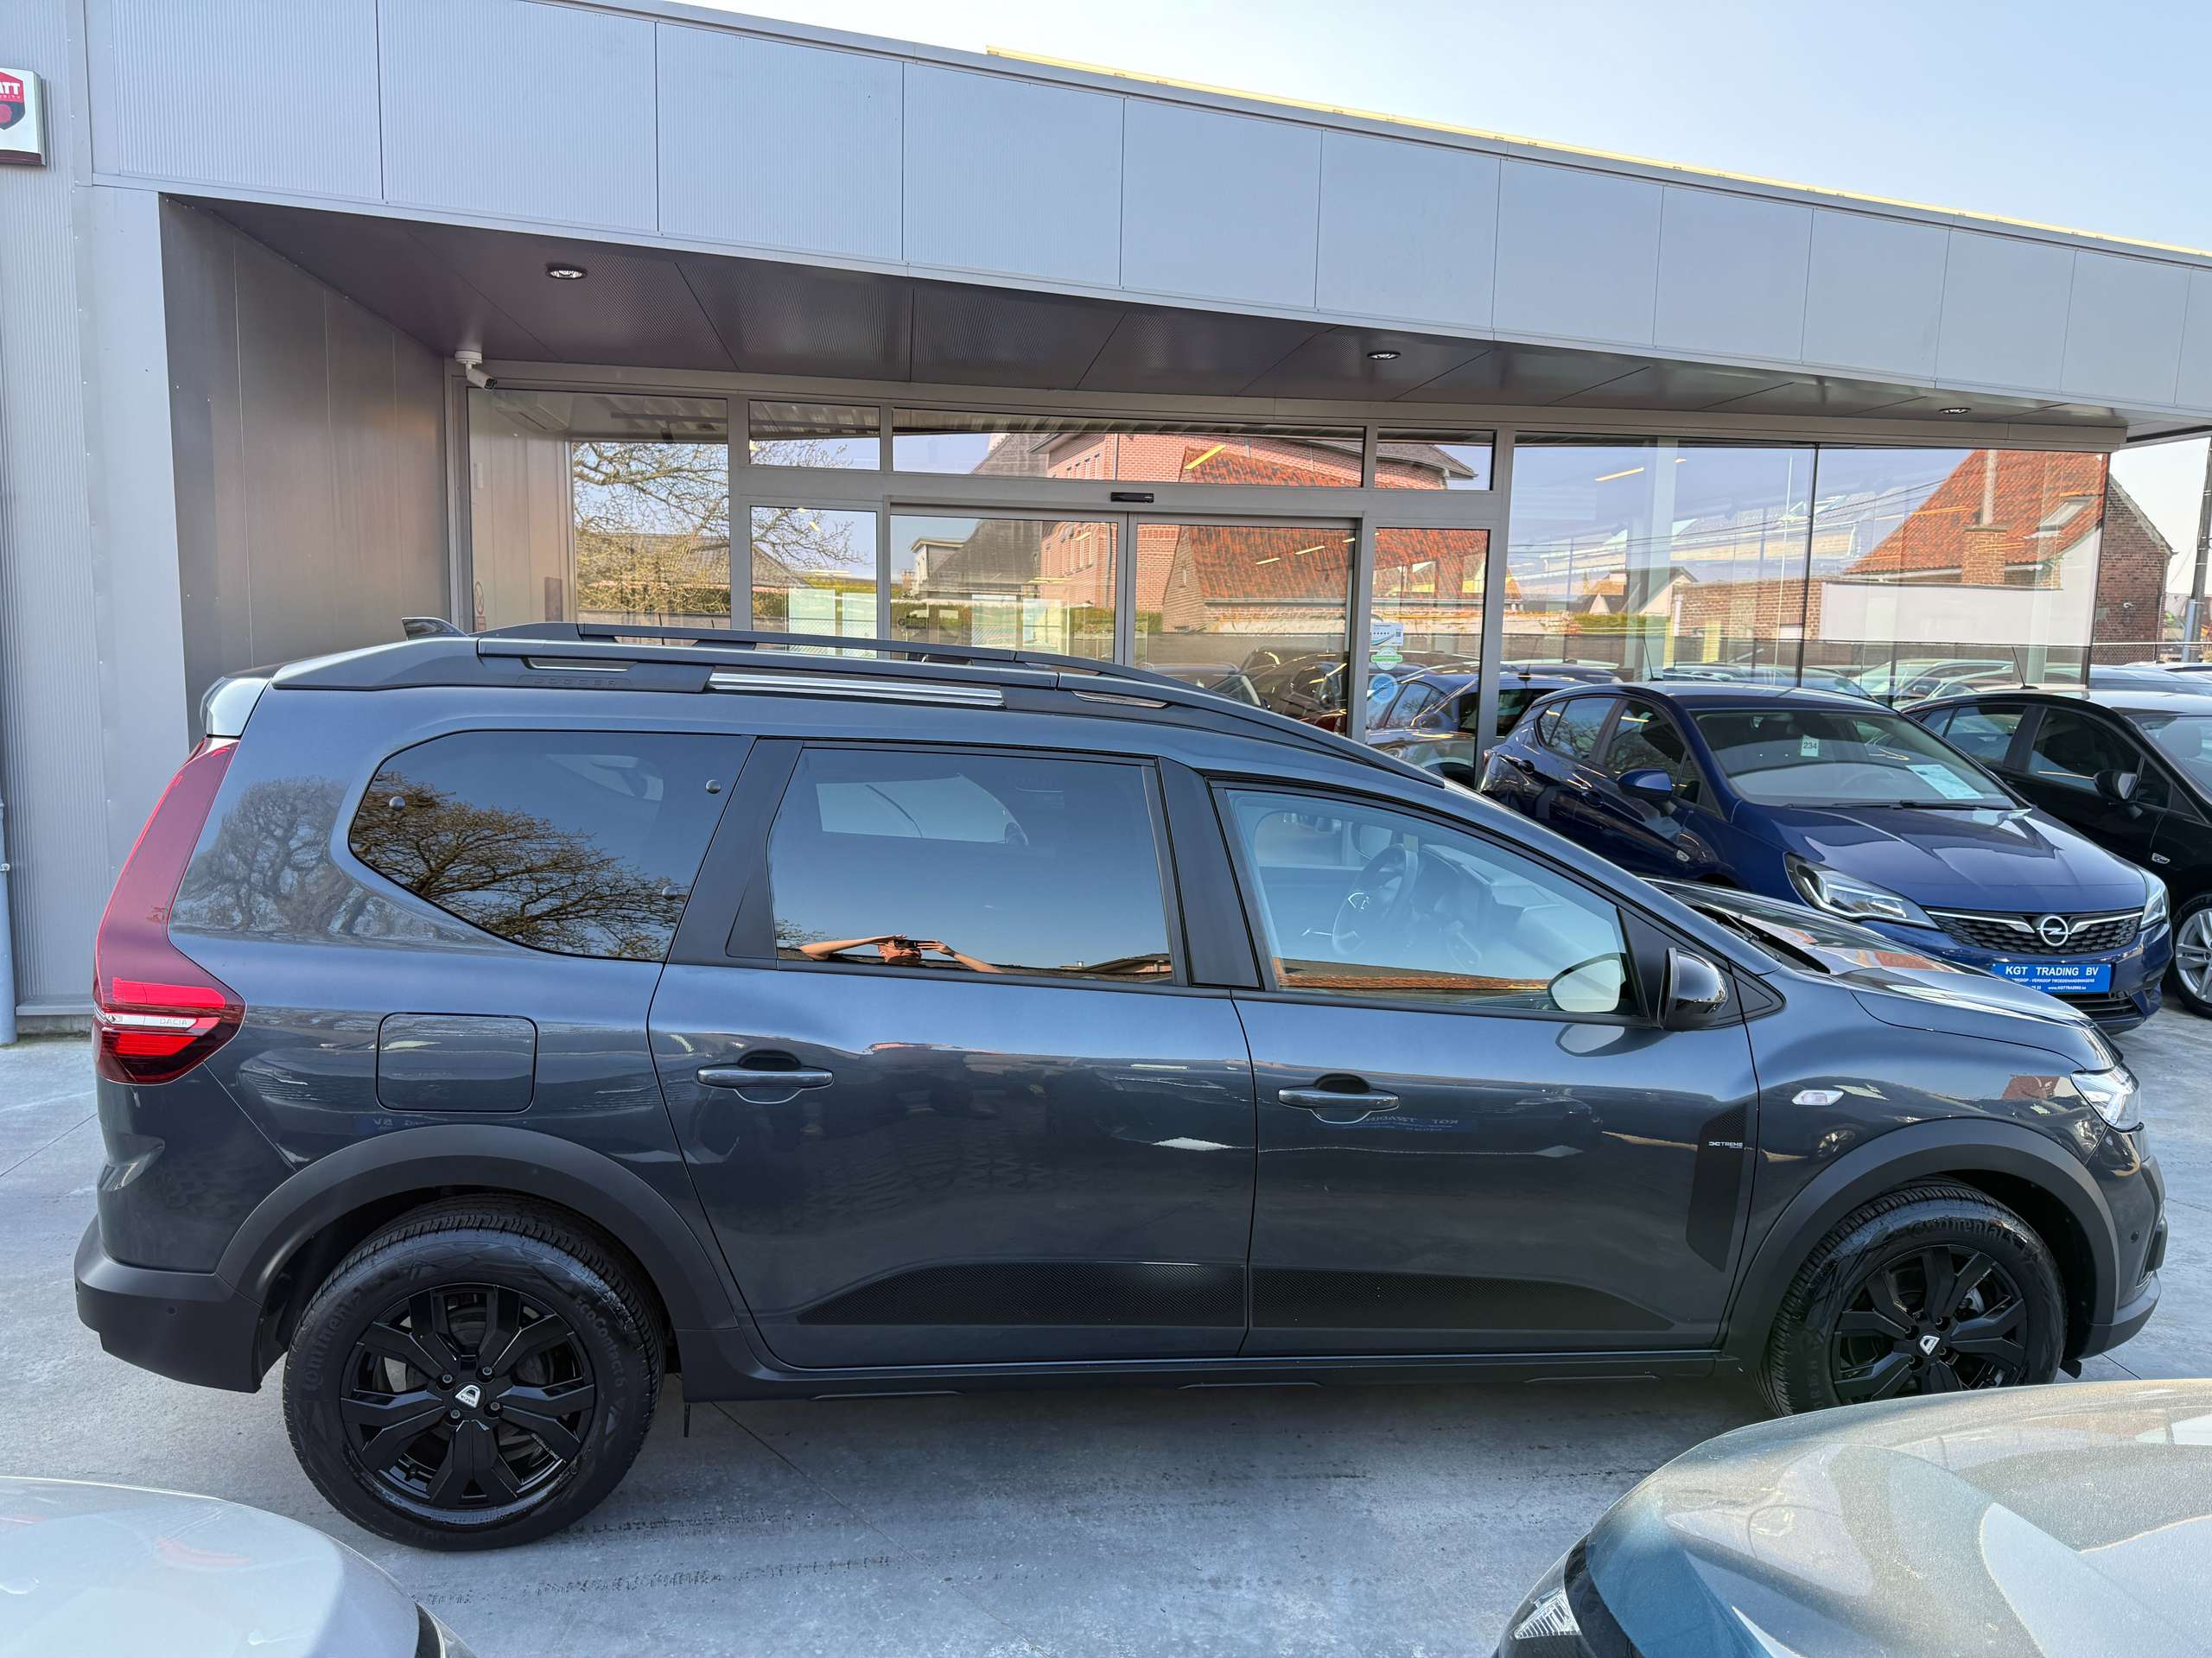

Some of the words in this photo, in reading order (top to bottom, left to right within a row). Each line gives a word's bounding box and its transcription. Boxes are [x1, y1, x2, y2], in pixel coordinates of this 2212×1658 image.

[2005, 965, 2028, 975] KGT
[2036, 966, 2079, 976] TRADING
[2086, 967, 2099, 975] BV
